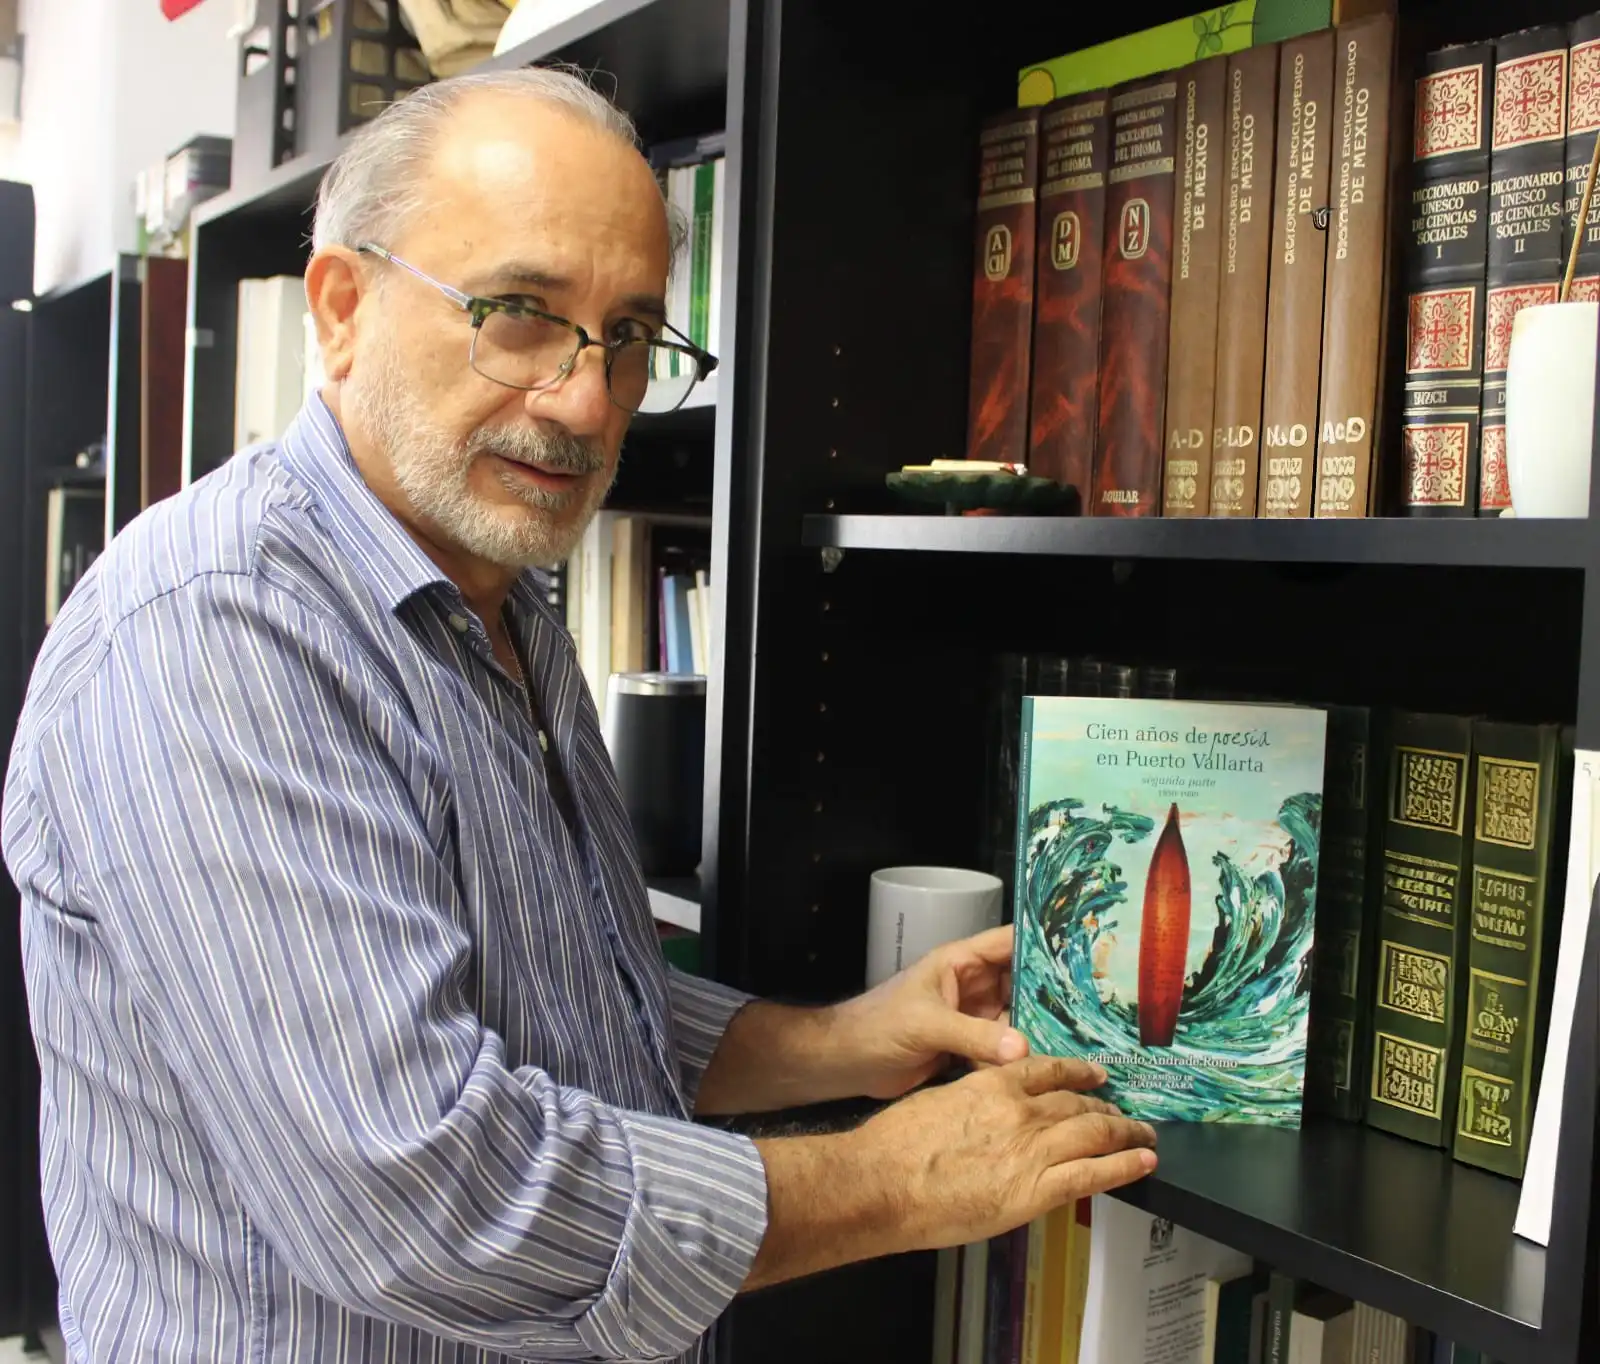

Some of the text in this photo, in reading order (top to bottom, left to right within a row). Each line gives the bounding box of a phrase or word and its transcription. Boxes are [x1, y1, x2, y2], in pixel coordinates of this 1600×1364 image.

[1342, 40, 1357, 157] ENCICLOPEDICO
[1290, 53, 1304, 168] ENCICLOPEDICO
[1130, 140, 1162, 159] IDIOMA
[1351, 87, 1370, 205] DE MEXICO
[1240, 113, 1255, 223] DE MEXICO
[1299, 100, 1317, 215] DE MEXICO
[1181, 80, 1196, 280] DICCIONARIO ENCICLOPEDICO
[1193, 123, 1208, 230] DE MEXICO
[1227, 68, 1243, 274] DICCIONARIO ENCICLOPEDICO
[1413, 180, 1480, 203] DICCIONARIO
[1491, 170, 1563, 196] DICCIONARIO
[1422, 197, 1464, 216] UNESCO
[1500, 188, 1546, 207] UNESCO
[1565, 197, 1580, 213] DE
[1128, 206, 1141, 227] N
[1412, 210, 1477, 232] DE CIENCIAS
[1490, 202, 1561, 226] DE CIENCIAS
[1060, 220, 1072, 238] D
[1417, 225, 1468, 245] SOCIALES
[1496, 218, 1550, 239] SOCIALES
[992, 236, 1002, 251] A
[1058, 242, 1071, 261] M
[1127, 232, 1140, 251] Z
[1514, 239, 1525, 253] II
[1435, 245, 1442, 260] I
[1102, 490, 1139, 504] AGUILAR
[1086, 723, 1129, 741] Cien
[1135, 725, 1179, 743] años
[1185, 726, 1208, 745] de
[1096, 750, 1265, 773] en Puerto Vallarta
[1141, 774, 1217, 789] segunda parte
[1087, 1051, 1239, 1069] Edmundo Andrade Romo
[1127, 1081, 1194, 1090] GUADALAJARA
